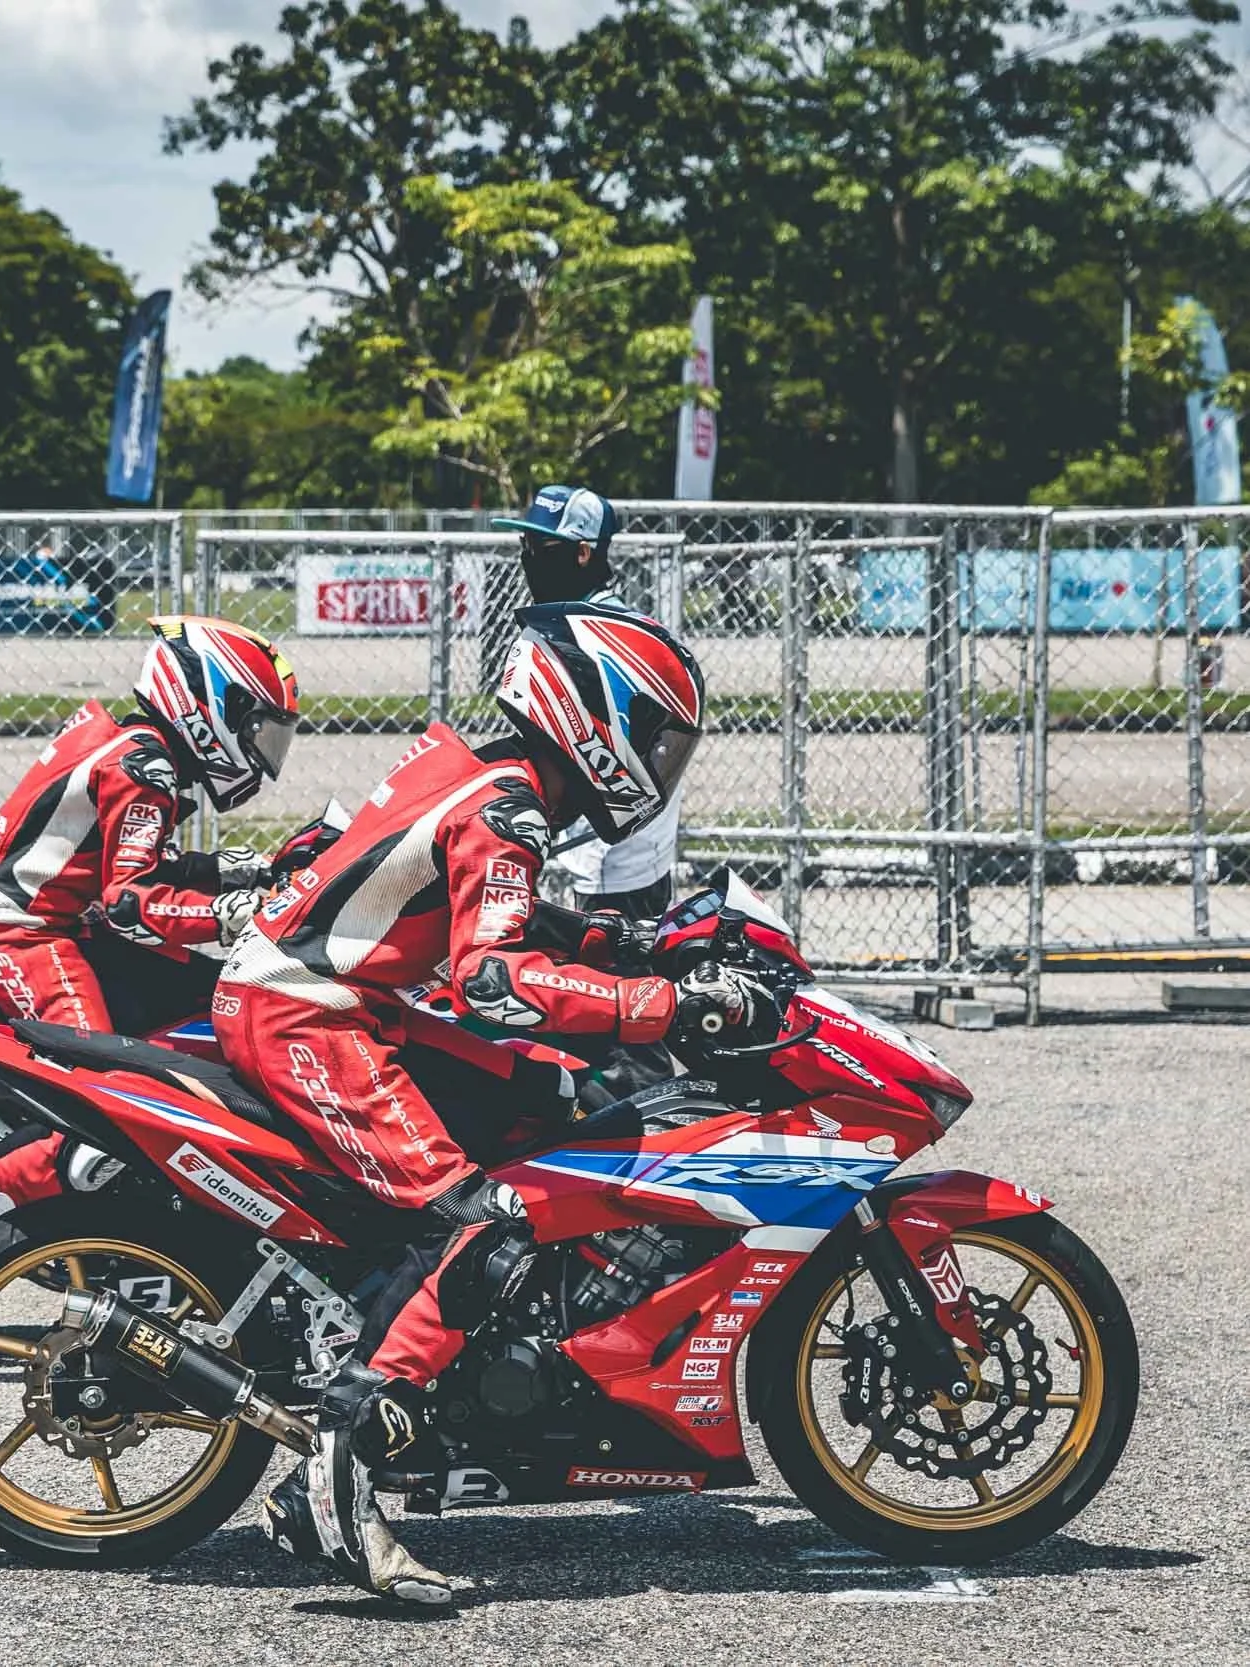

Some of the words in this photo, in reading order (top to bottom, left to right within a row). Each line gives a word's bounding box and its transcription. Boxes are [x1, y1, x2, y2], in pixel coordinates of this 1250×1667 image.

[172, 682, 188, 714] HONDA
[560, 696, 583, 736] HONDA
[183, 710, 239, 768] KYT
[574, 732, 650, 796] KYT
[129, 805, 159, 820] RK
[492, 861, 526, 882] RK
[147, 902, 215, 918] HOND
[484, 887, 528, 911] NGK
[630, 978, 670, 1020] BENKIA
[386, 1094, 438, 1167] RACING
[807, 1130, 842, 1138] HONDA
[201, 1170, 275, 1223] idemitsu
[752, 1262, 788, 1273] SCK
[128, 1279, 165, 1312] 5
[685, 1362, 717, 1373] NGK
[573, 1471, 696, 1487] HONDA
